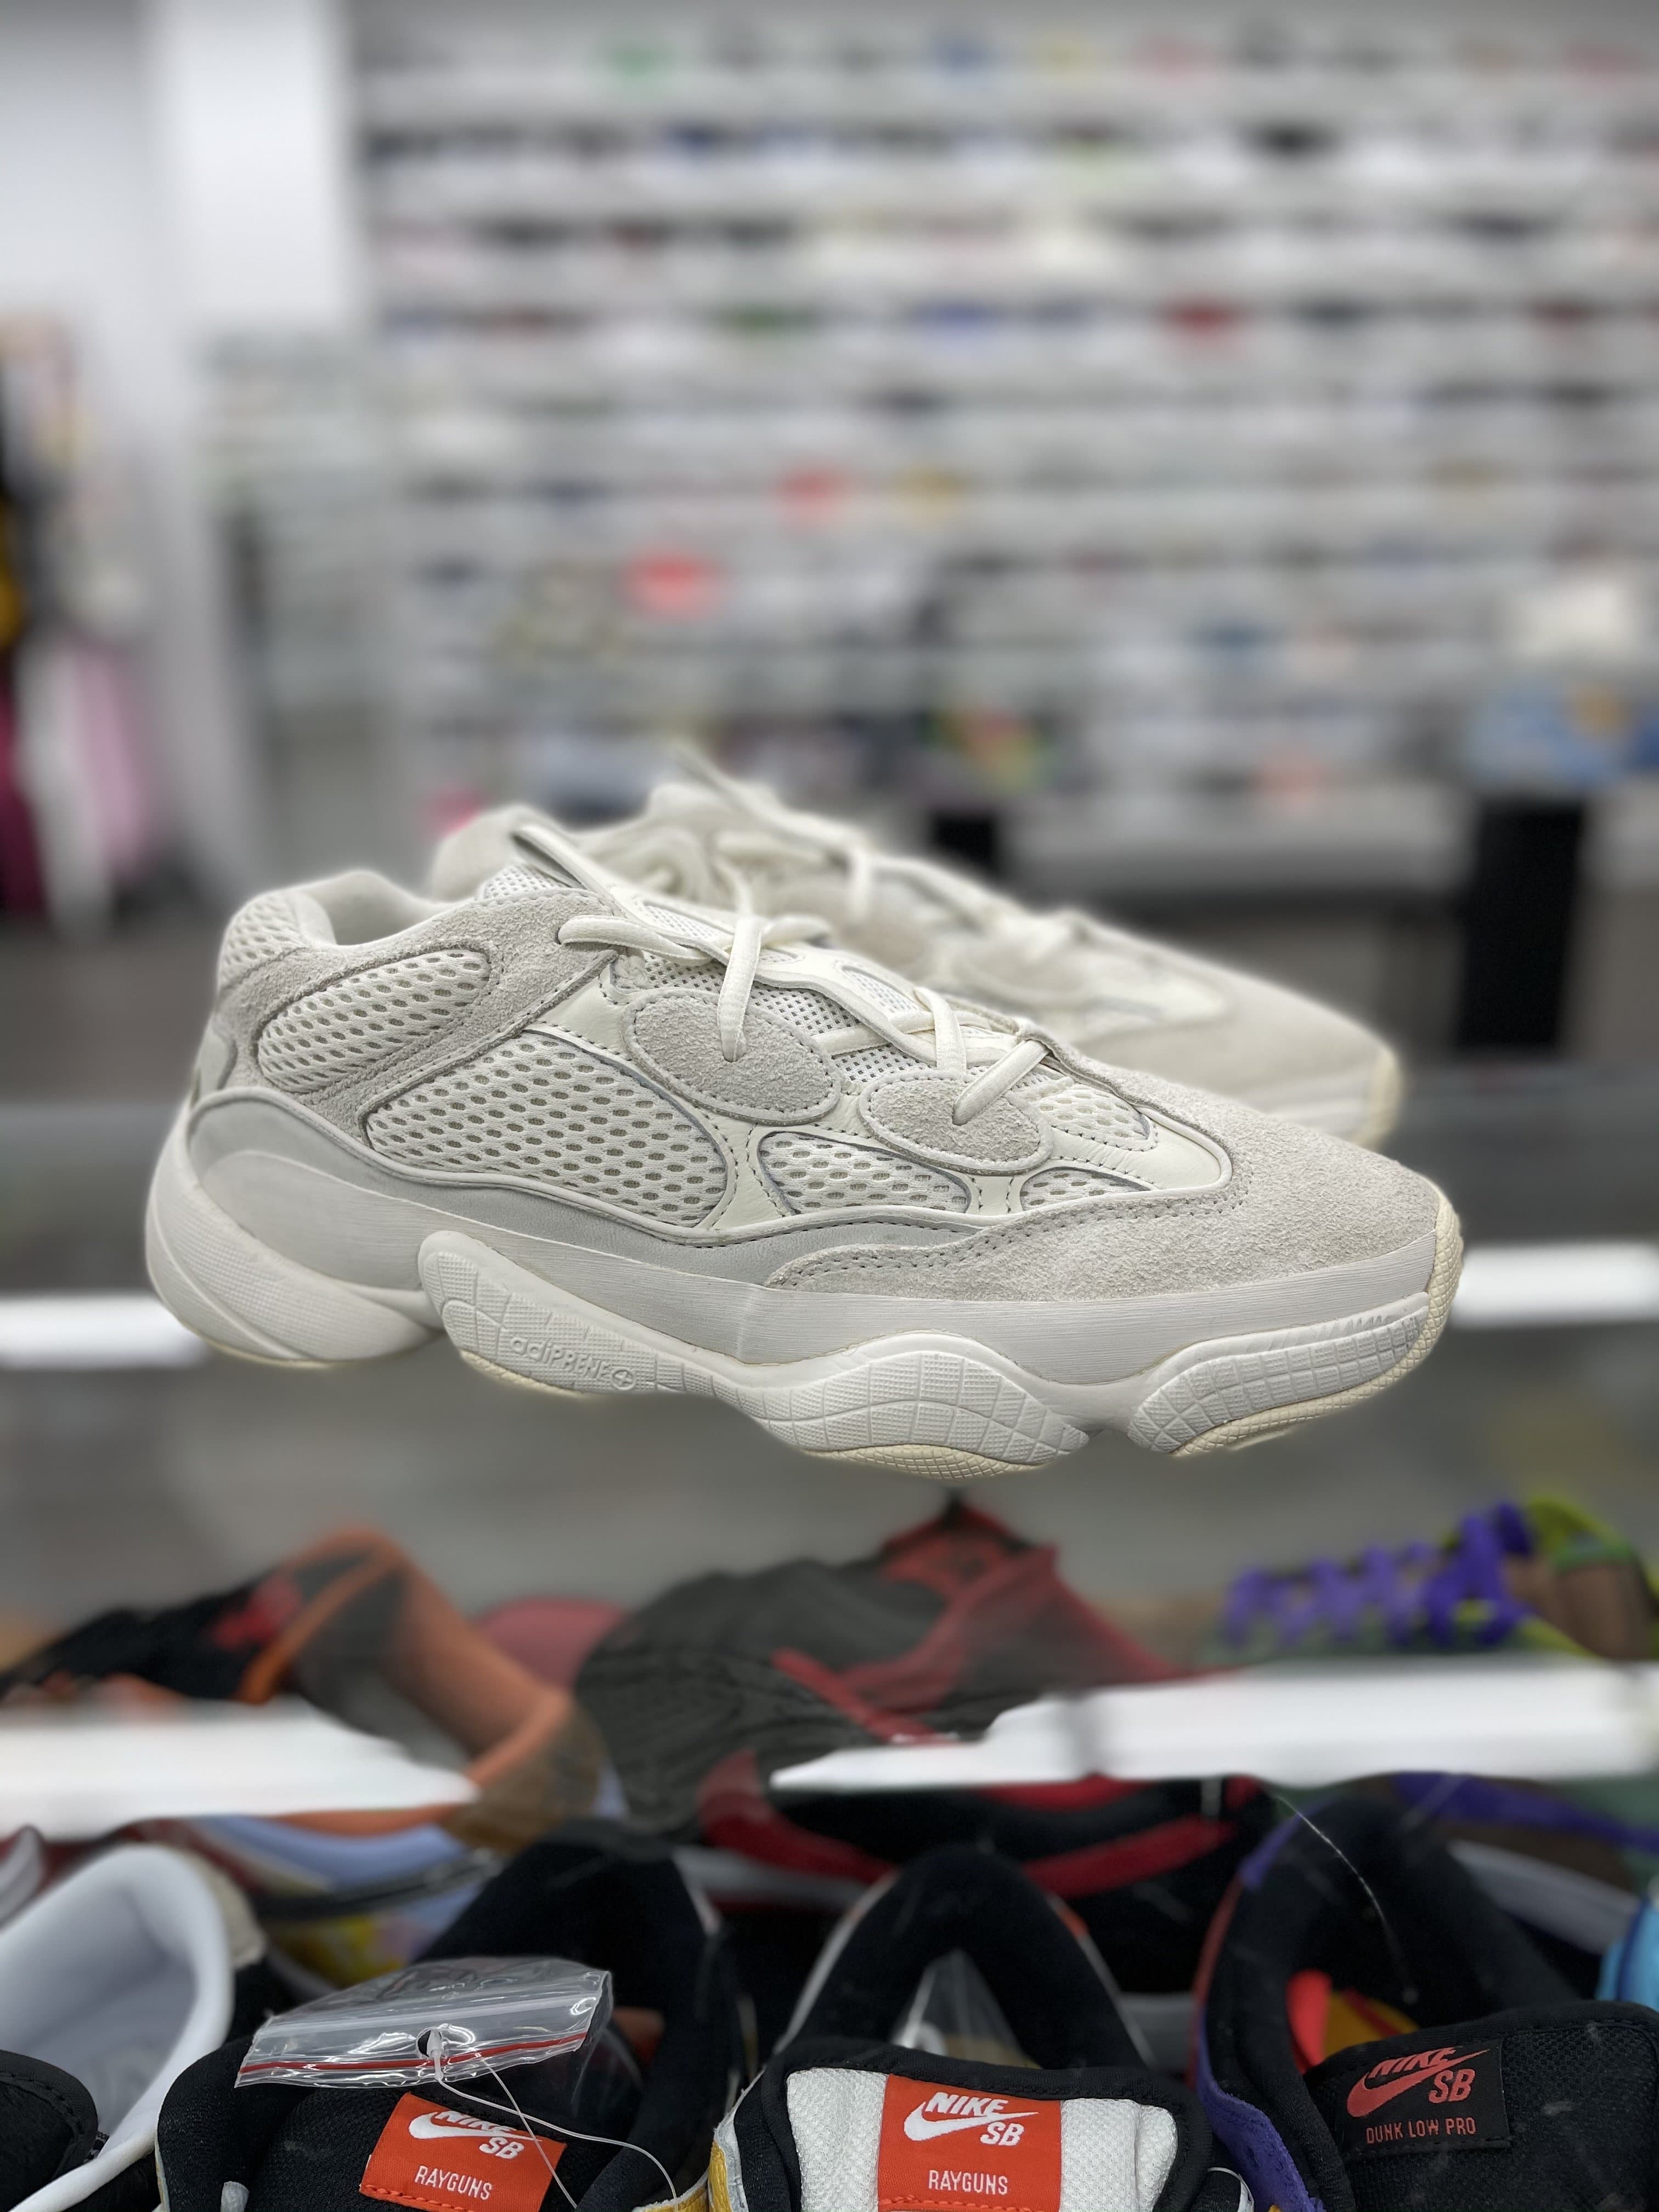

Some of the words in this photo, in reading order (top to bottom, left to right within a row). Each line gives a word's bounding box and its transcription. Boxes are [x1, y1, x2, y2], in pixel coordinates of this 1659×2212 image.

[1368, 2046, 1461, 2078] NIKE
[1428, 2069, 1476, 2103] SB
[925, 2092, 1009, 2116] NIKE
[435, 2111, 517, 2131] NIKE
[980, 2121, 1024, 2146] SB
[1366, 2121, 1403, 2145] DUNK
[1408, 2119, 1439, 2138] LOW
[1445, 2117, 1476, 2136] PRO
[479, 2137, 524, 2159] SB
[414, 2165, 492, 2200] RAYGUNS
[928, 2170, 1008, 2196] RAYGUNS
